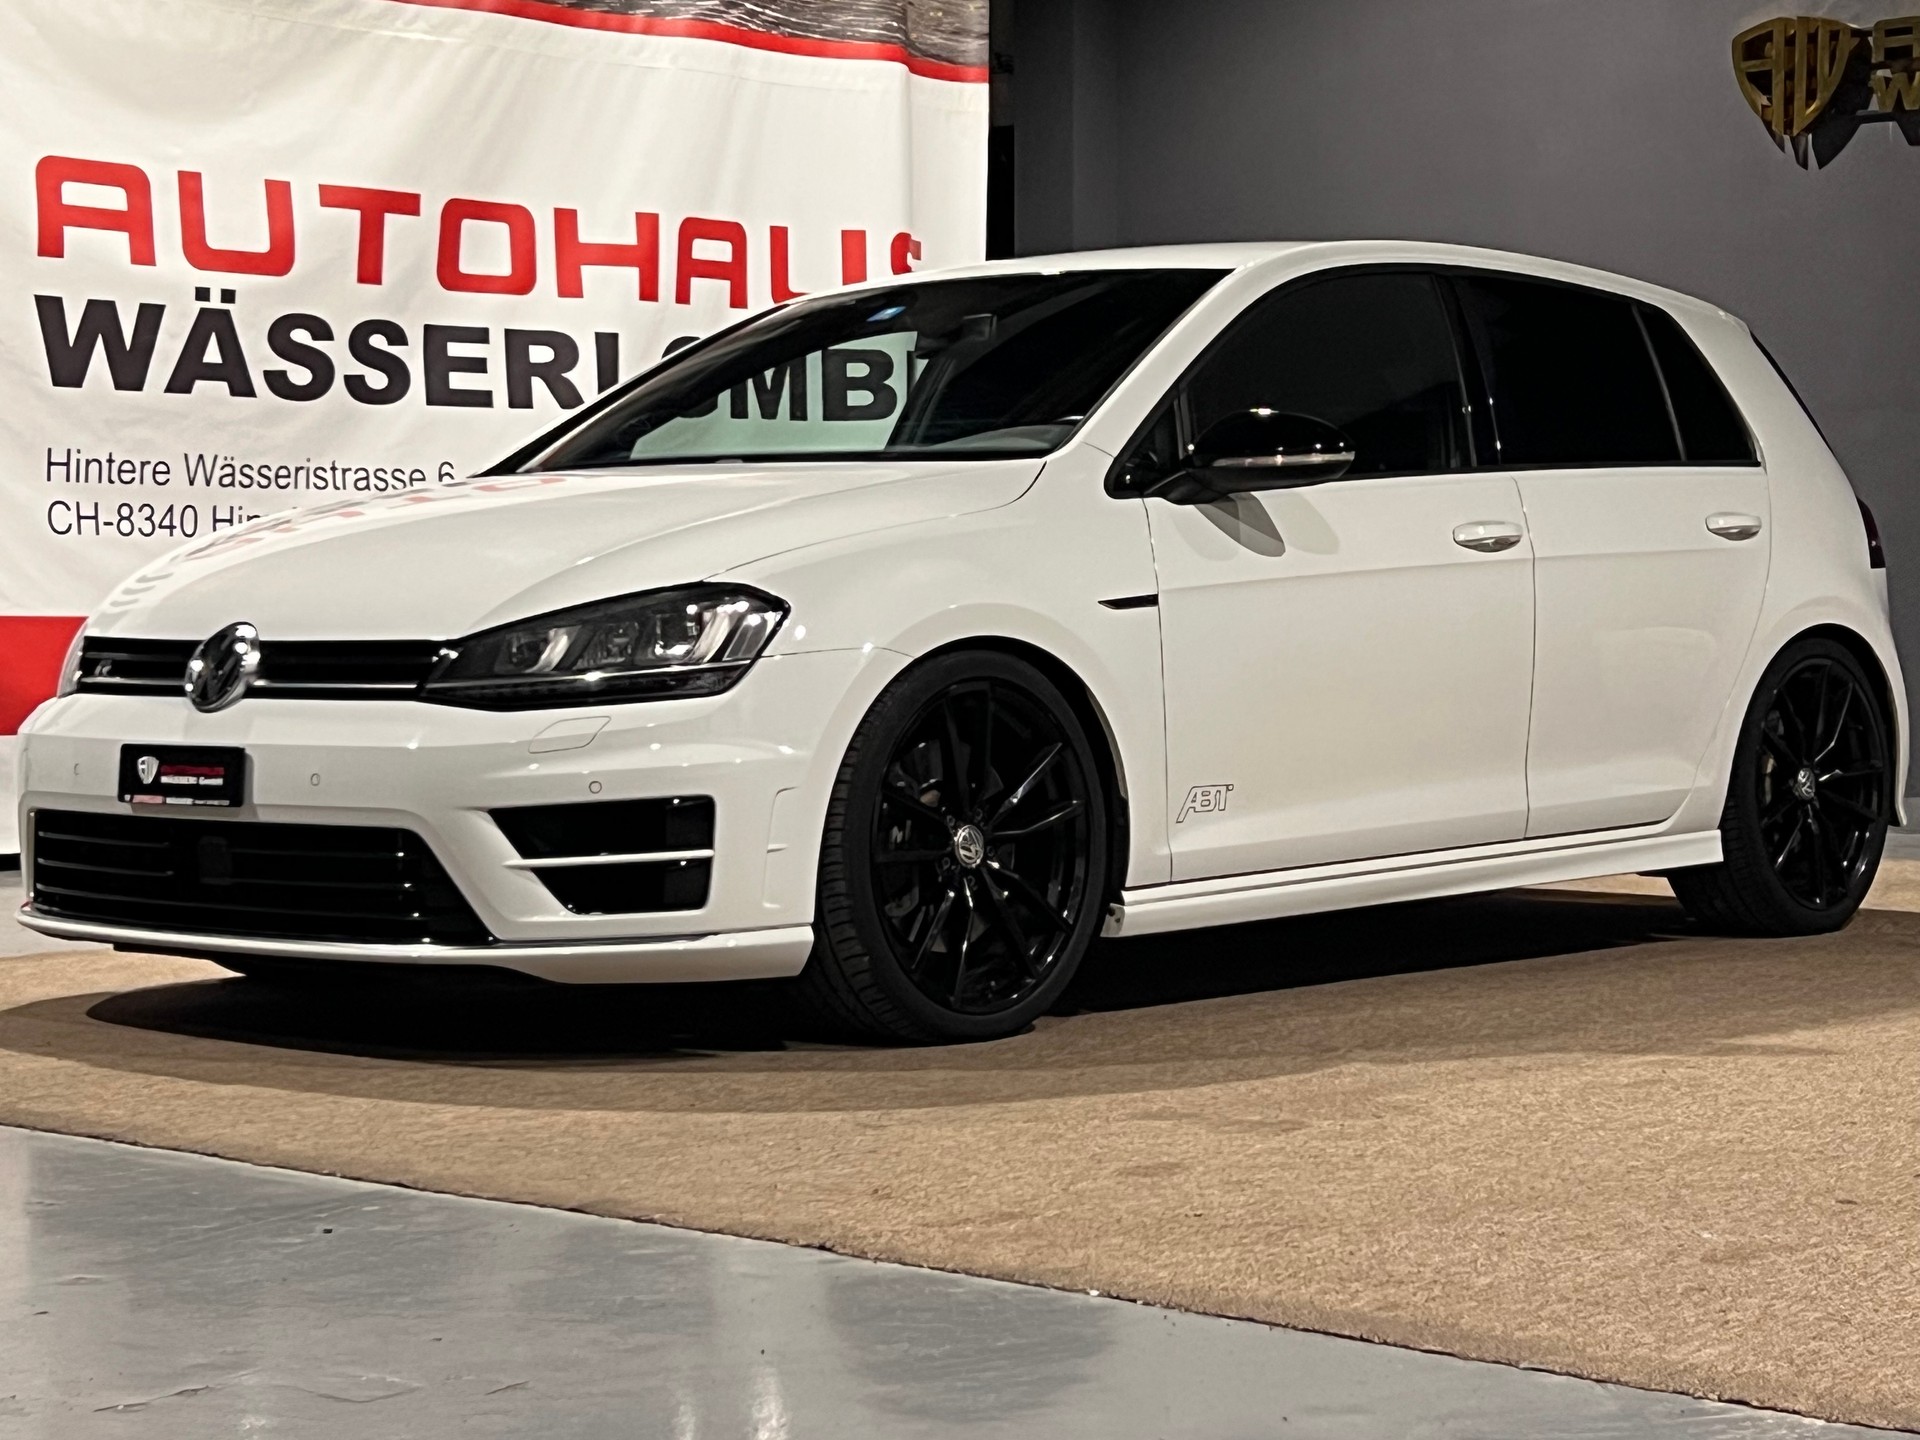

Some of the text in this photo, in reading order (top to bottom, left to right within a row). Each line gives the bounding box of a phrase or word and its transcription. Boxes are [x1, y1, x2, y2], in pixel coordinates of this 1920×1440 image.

[46, 447, 171, 486] Hintere
[183, 452, 427, 492] Wässeristrasse
[47, 500, 198, 538] CH-8340
[1176, 783, 1235, 824] ABT
